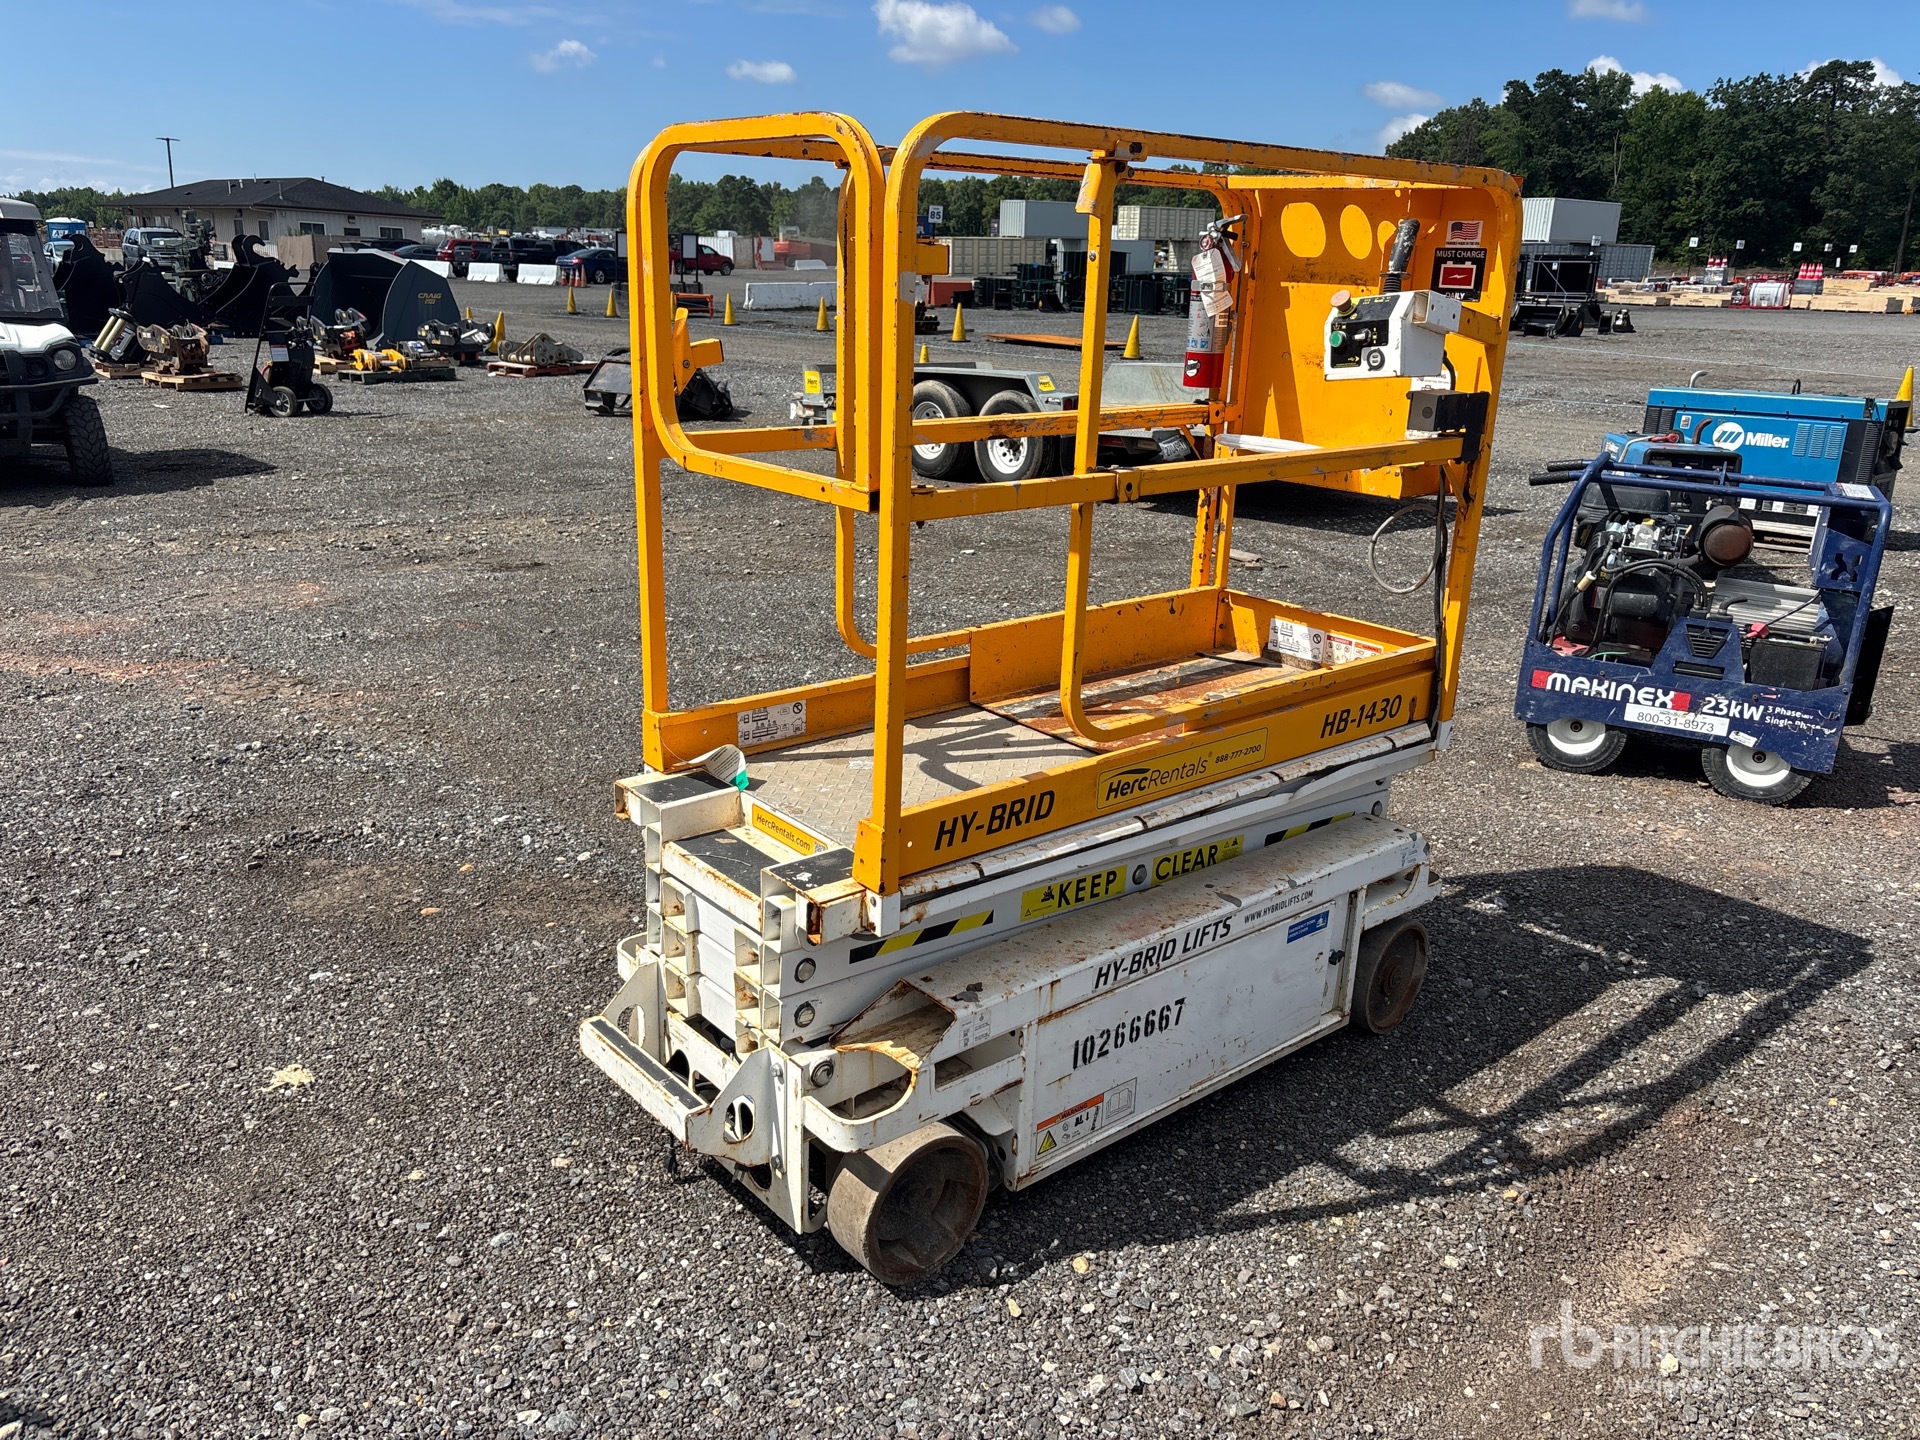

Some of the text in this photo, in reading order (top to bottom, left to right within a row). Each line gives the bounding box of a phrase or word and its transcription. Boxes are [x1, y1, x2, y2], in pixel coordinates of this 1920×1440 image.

[930, 211, 941, 220] 85
[1436, 250, 1485, 258] MUST CHARGE
[1446, 292, 1466, 300] DAILY
[1546, 672, 1677, 709] MAKINEX
[1320, 694, 1403, 739] HB-1430
[1637, 712, 1715, 733] 800-31-8973
[1702, 696, 1765, 721] 23kW
[1767, 705, 1773, 713] 3
[1775, 707, 1802, 718] Phase
[1215, 744, 1262, 764] 888-777-2700
[756, 813, 811, 852] HercRentals.com
[934, 790, 1055, 851] HY-BRID
[1057, 845, 1219, 909] KEEP CLEAR
[1244, 889, 1314, 924] WWW.HYBRIDLIFTS.COM
[1095, 916, 1232, 989] HY-BRID LIFTS
[1072, 997, 1187, 1071] 10266667
[1061, 1103, 1088, 1120] WARNING
